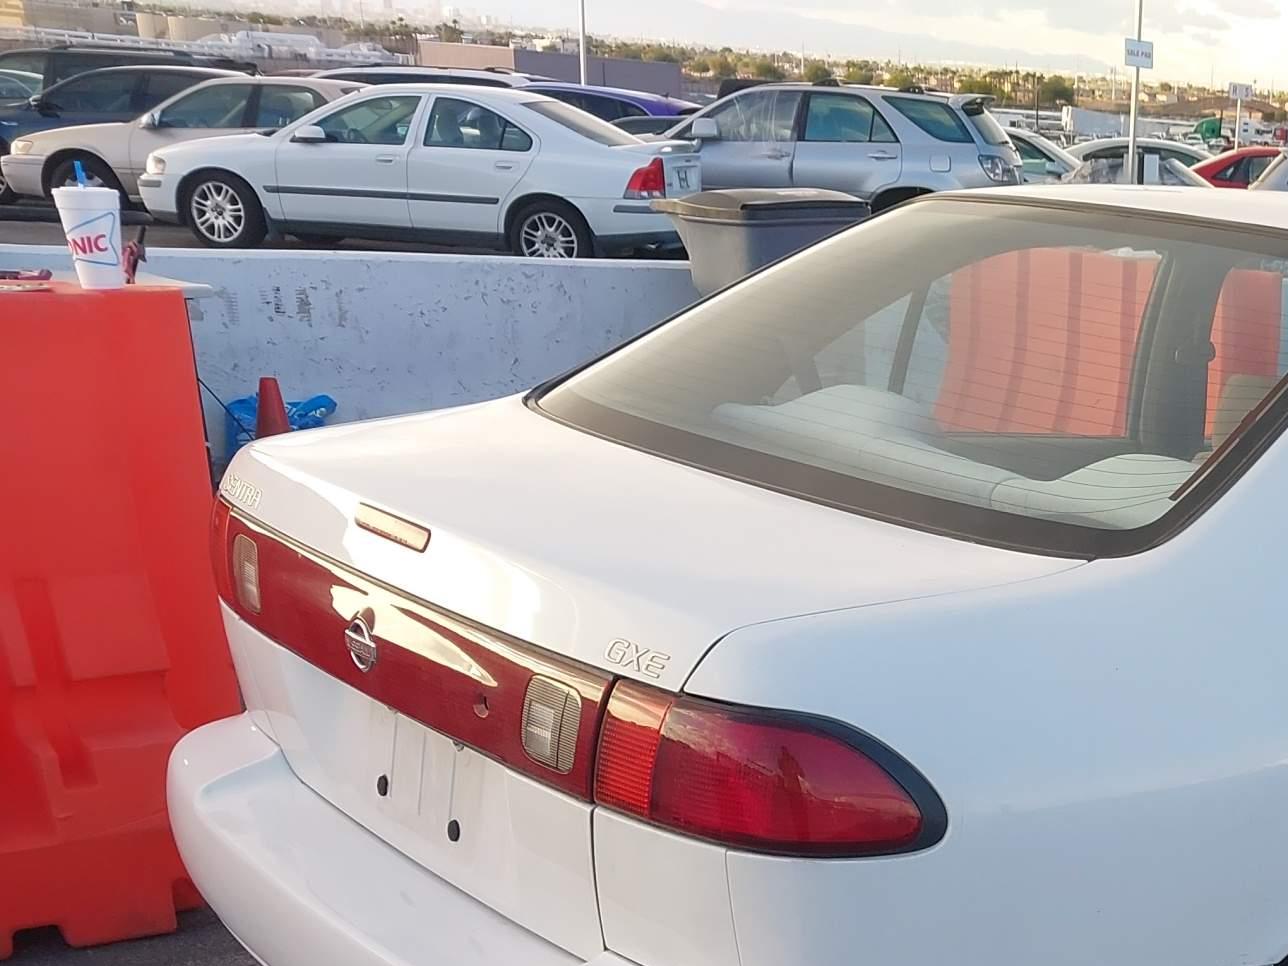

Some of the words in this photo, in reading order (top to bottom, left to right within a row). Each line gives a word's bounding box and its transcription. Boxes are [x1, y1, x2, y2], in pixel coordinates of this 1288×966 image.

[68, 234, 108, 255] NIC
[223, 473, 264, 509] SENTRA
[603, 638, 671, 679] GXE
